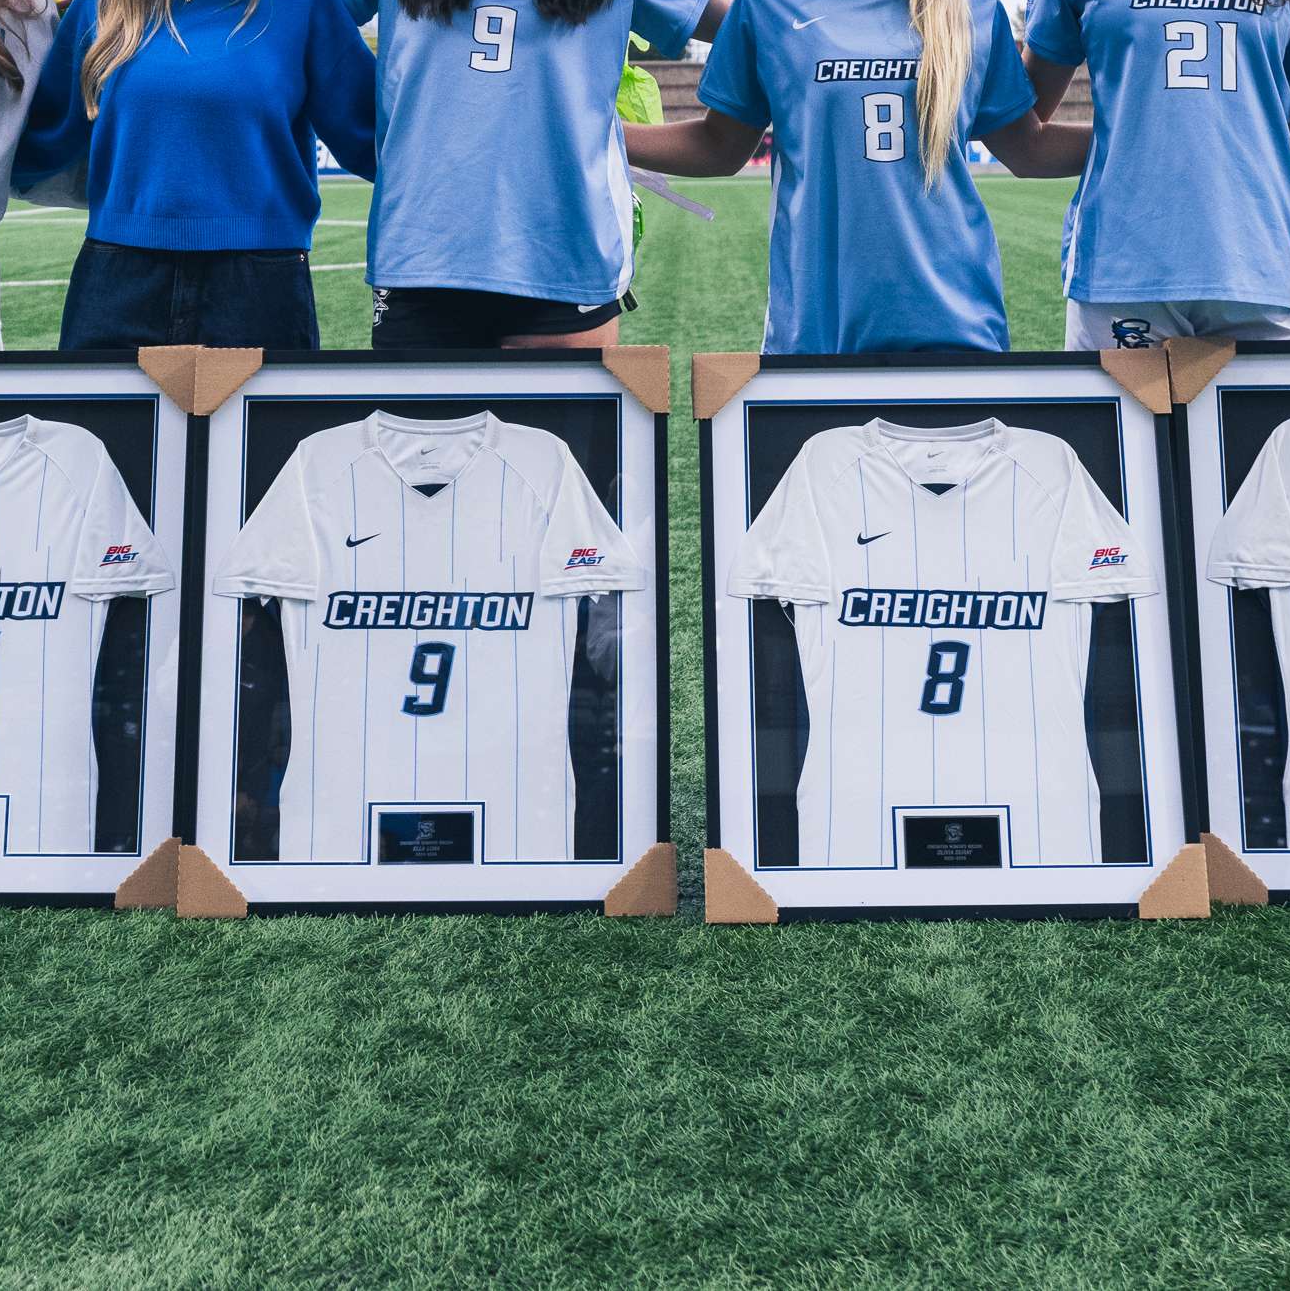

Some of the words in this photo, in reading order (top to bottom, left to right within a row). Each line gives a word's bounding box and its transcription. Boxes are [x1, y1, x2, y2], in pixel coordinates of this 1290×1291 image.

[468, 5, 518, 73] 9
[814, 58, 924, 82] CREIGHT
[1164, 20, 1238, 92] 21
[861, 92, 905, 162] 8
[102, 552, 139, 562] EAST
[106, 544, 132, 555] BIG
[566, 556, 605, 565] EAST
[571, 548, 598, 557] BIG
[1091, 555, 1128, 565] EAST
[1094, 547, 1120, 558] BIG
[323, 591, 535, 630] CREIGHTON
[838, 588, 1047, 630] CREIGHTON
[401, 641, 456, 717] 9
[918, 639, 971, 716] 8
